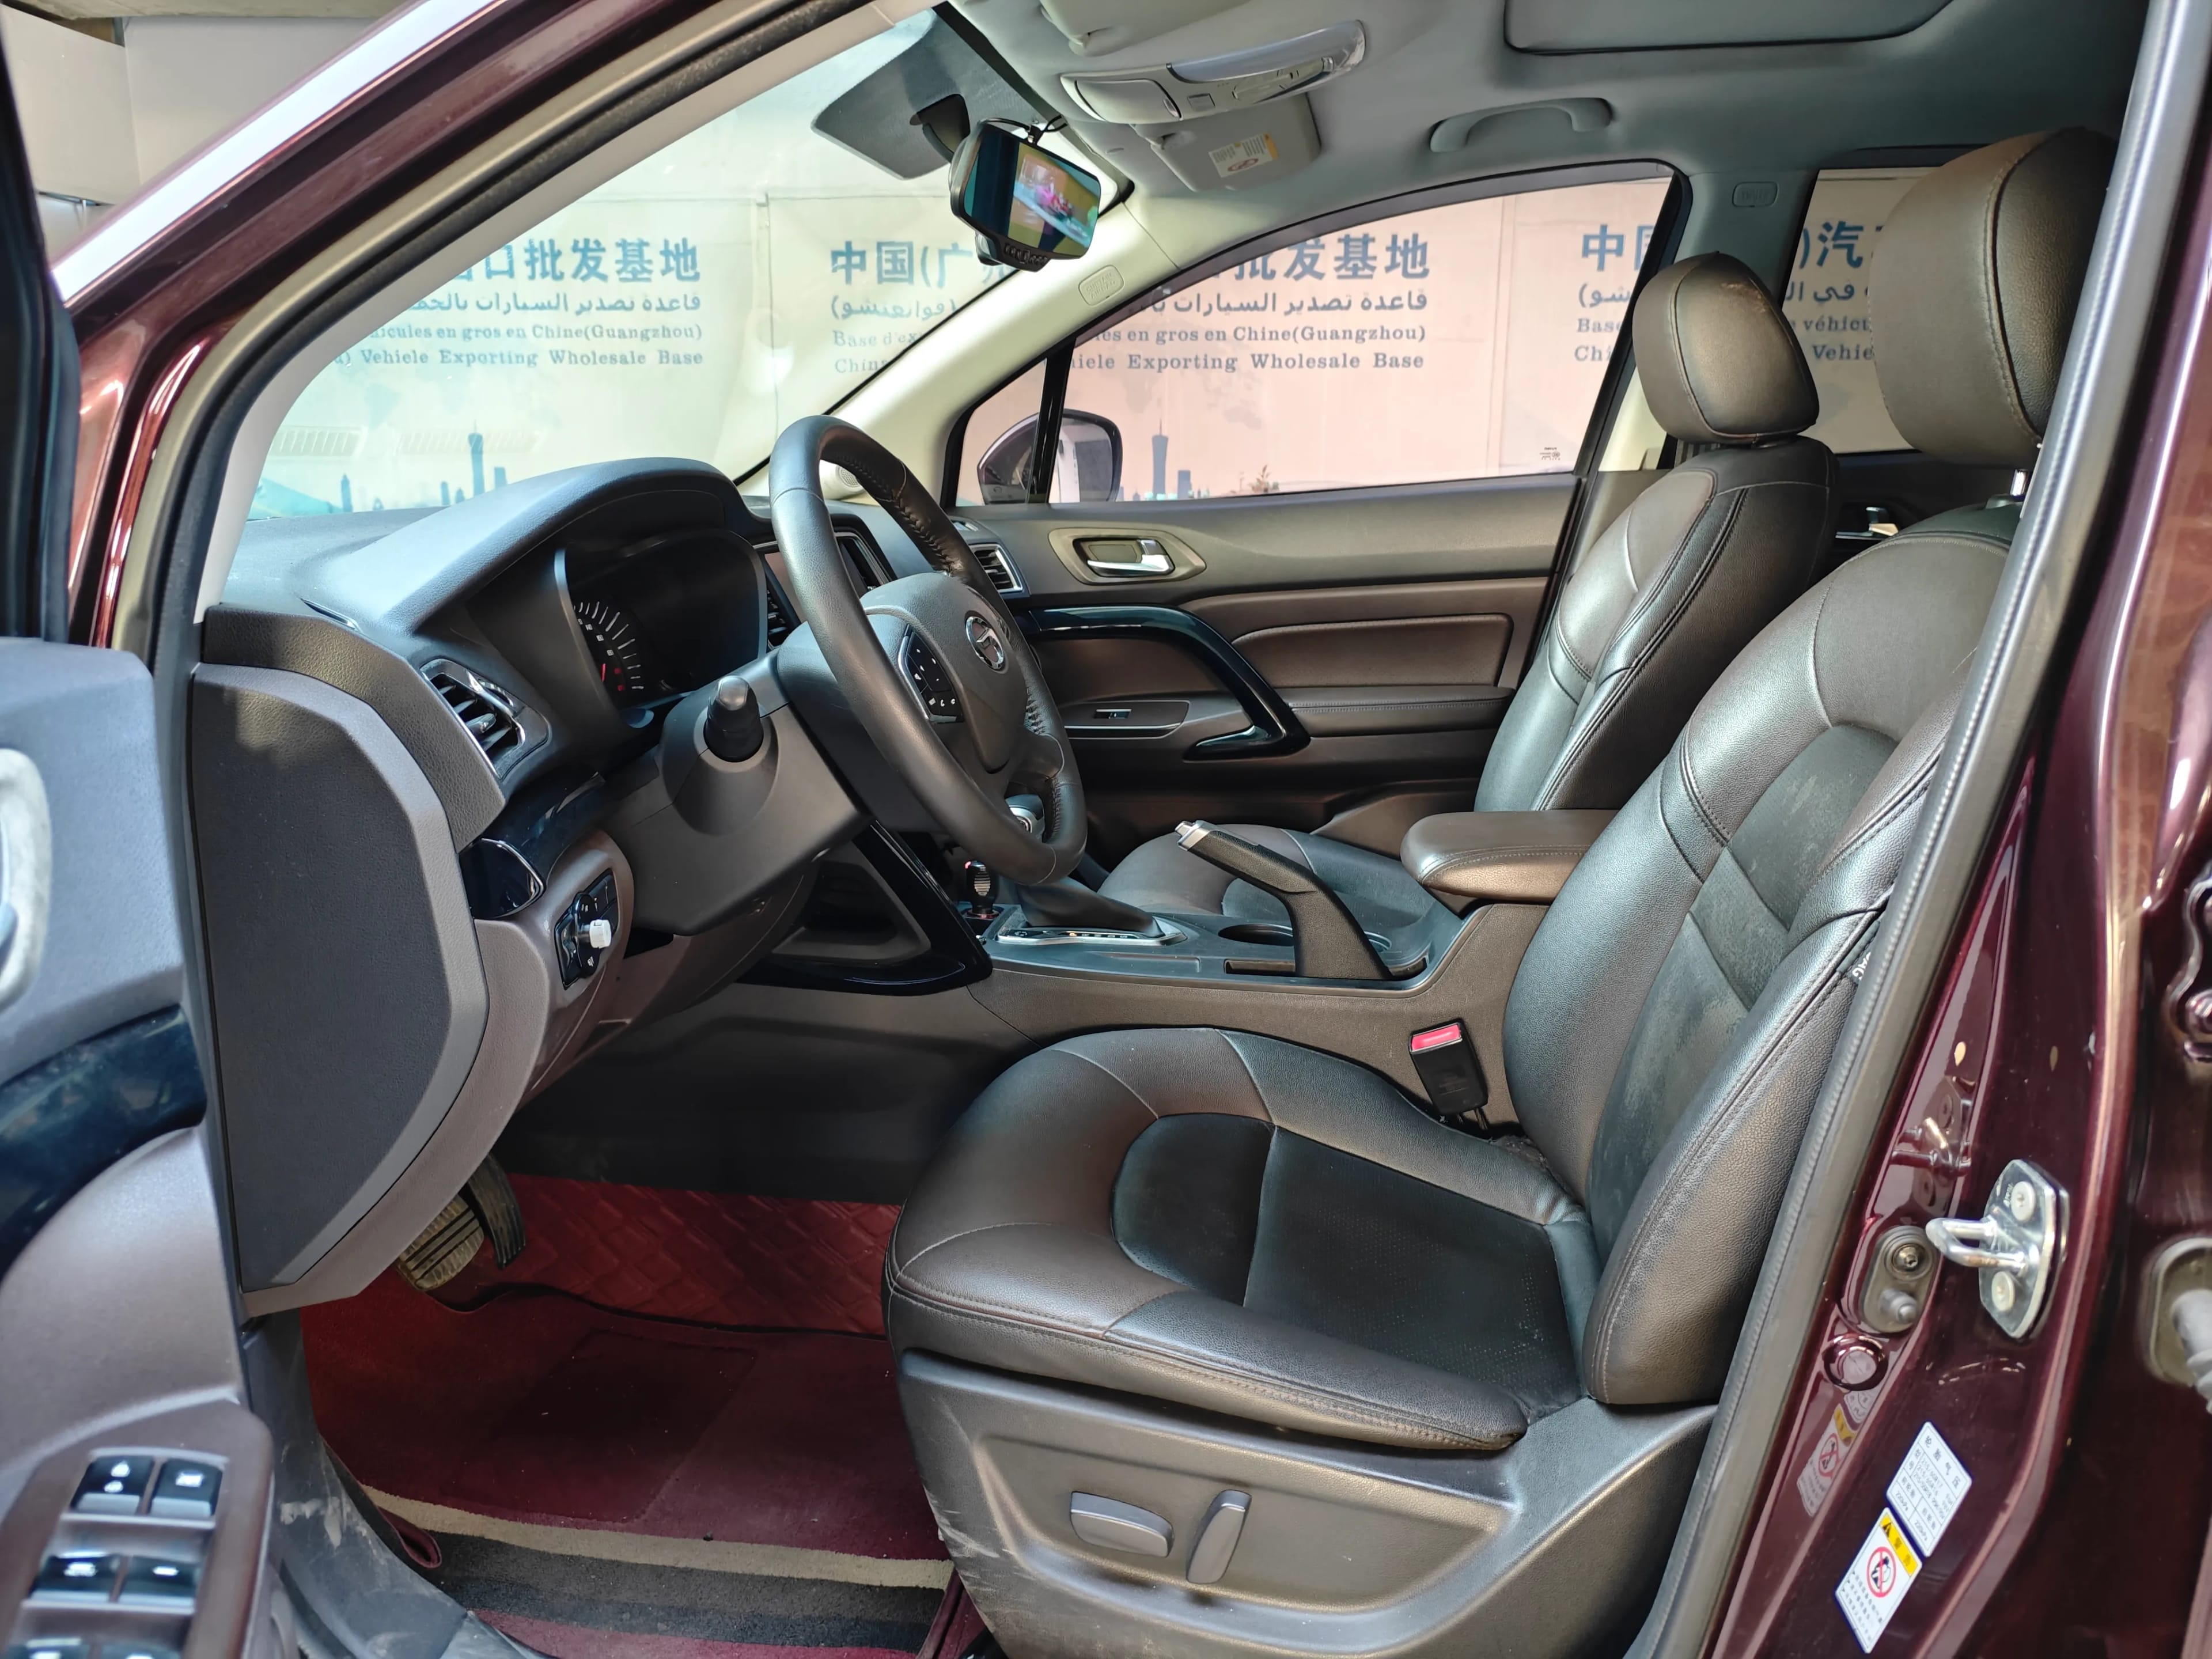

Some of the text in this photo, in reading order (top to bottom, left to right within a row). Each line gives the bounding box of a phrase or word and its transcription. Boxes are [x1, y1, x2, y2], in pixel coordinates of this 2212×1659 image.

[1798, 221, 1883, 269] )汽
[454, 237, 700, 282] 口批发基地
[437, 327, 456, 339] en
[462, 327, 501, 341] gros
[506, 327, 527, 339] en
[1127, 329, 1149, 341] en
[1156, 329, 1198, 345] gros
[1205, 329, 1226, 341] en
[1233, 325, 1426, 344] Chine(Guangzhou)
[439, 349, 539, 367] Exporting
[549, 349, 646, 365] Wholesale
[657, 349, 704, 365] Base
[1128, 353, 1238, 373] Exporting
[1250, 353, 1361, 369] Wholesale
[1373, 352, 1425, 369] Base
